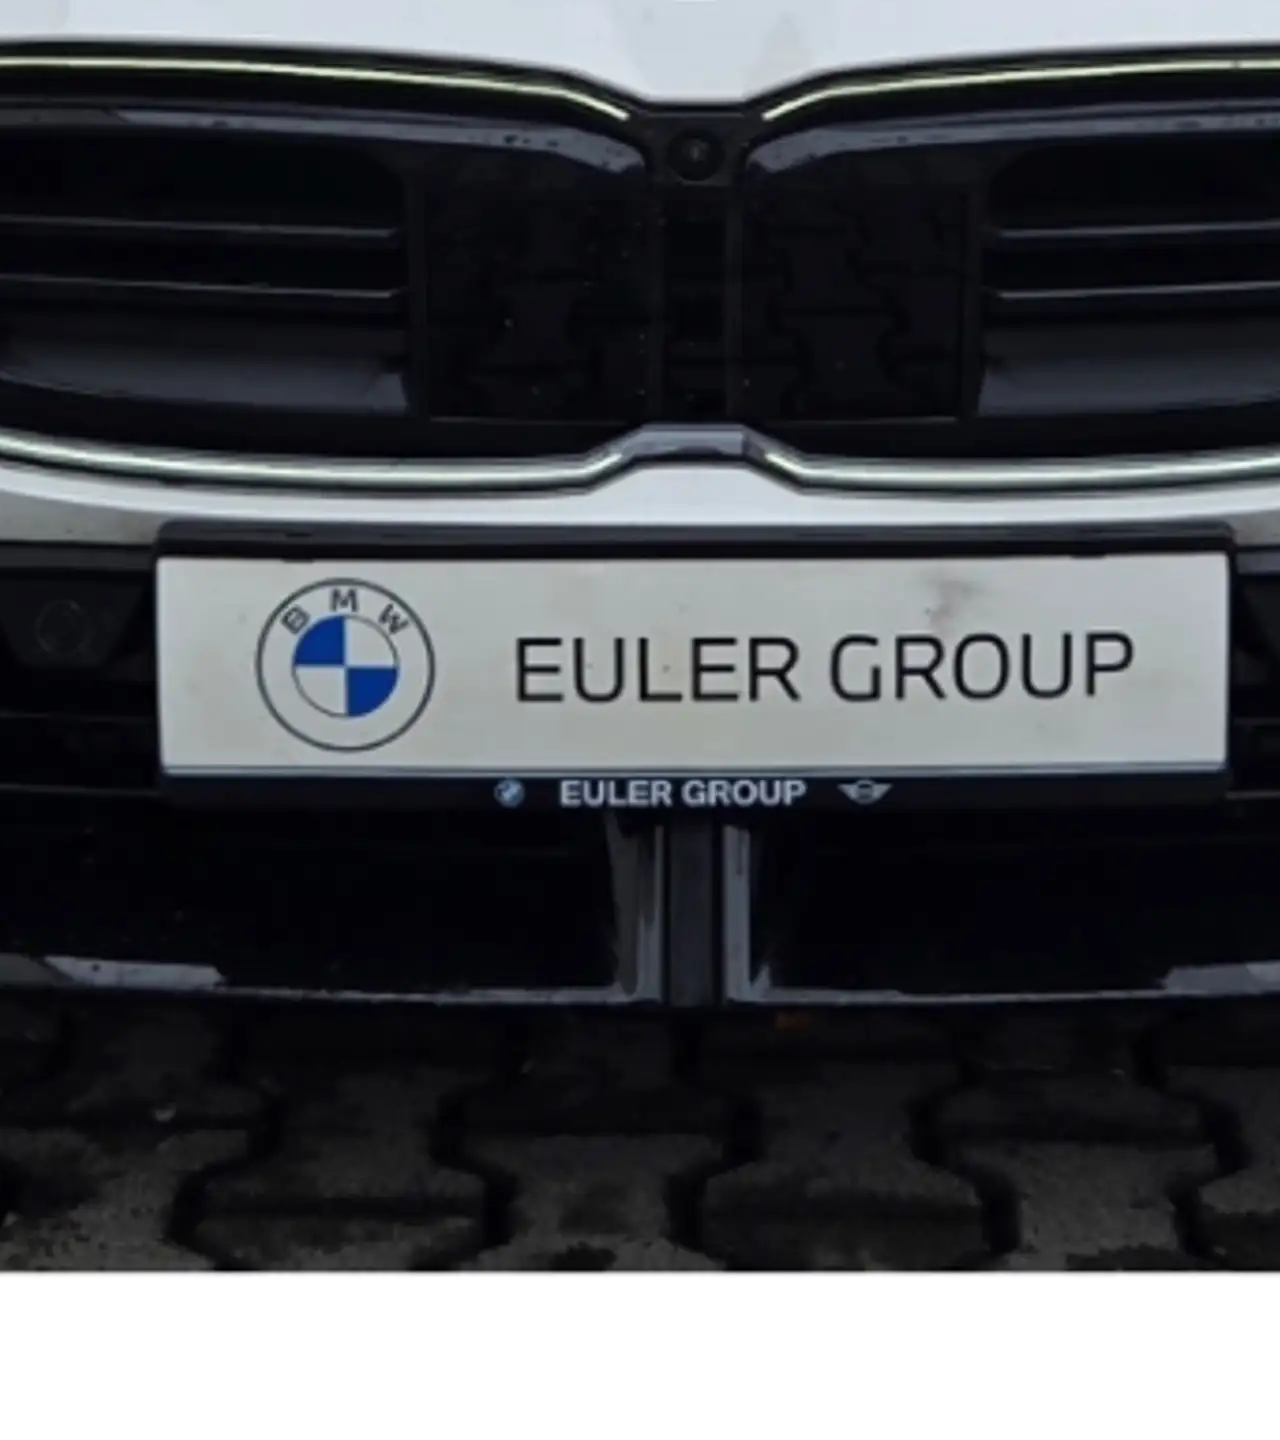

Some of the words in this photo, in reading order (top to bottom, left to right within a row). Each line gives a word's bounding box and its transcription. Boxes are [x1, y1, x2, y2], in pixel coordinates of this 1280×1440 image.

[280, 587, 410, 635] BMW
[516, 635, 802, 704] EULER
[829, 632, 1135, 704] GROUP
[558, 778, 674, 808] EULER
[680, 778, 808, 808] GROUP
